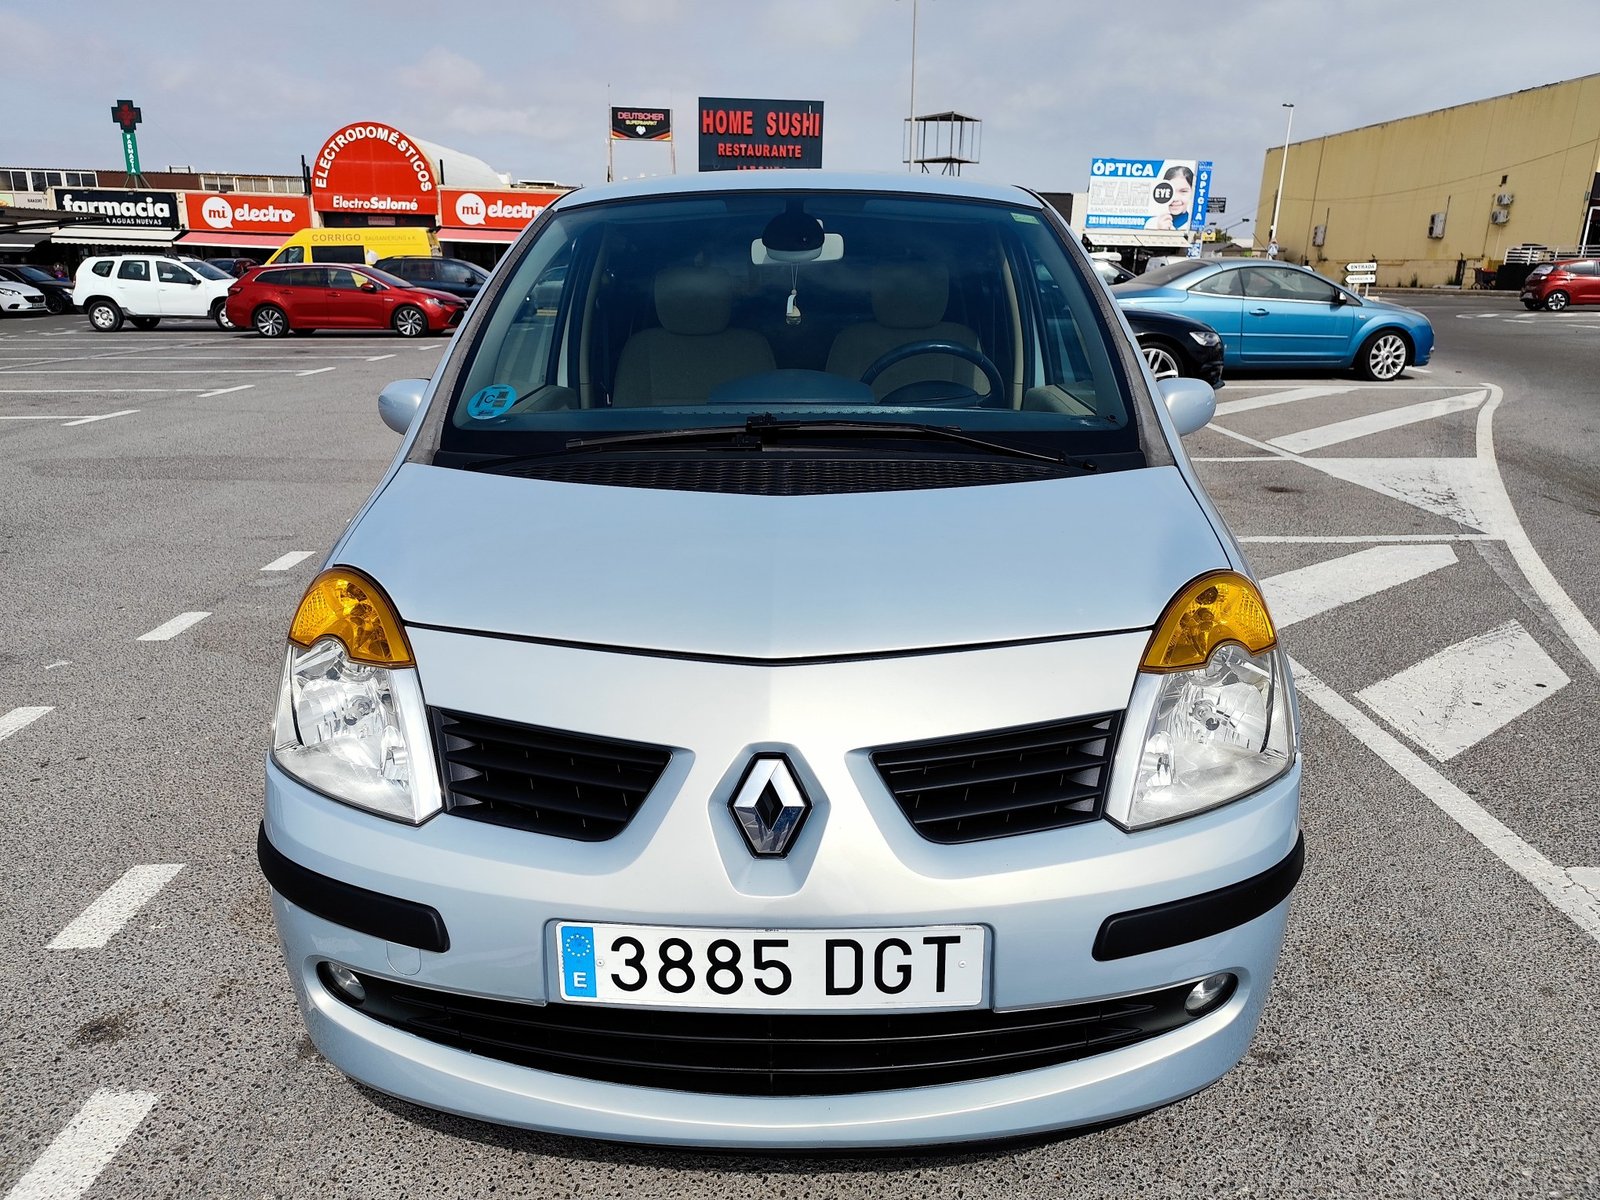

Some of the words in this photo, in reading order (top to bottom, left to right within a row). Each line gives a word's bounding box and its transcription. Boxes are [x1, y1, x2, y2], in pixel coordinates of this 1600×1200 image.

[617, 112, 664, 120] DEUTSCHER
[702, 110, 753, 135] HOME
[766, 112, 820, 137] SUSHI
[126, 134, 136, 173] FARMACIA
[315, 126, 432, 192] ELECTRODOMÉSTICOS
[718, 143, 802, 158] RESTAURANTE
[1092, 159, 1154, 177] ÓPTICA
[1154, 188, 1171, 198] EYE
[62, 194, 170, 217] farmacia
[333, 195, 418, 210] ElectroSalomé
[462, 203, 480, 215] mi
[208, 206, 228, 219] mi
[234, 203, 295, 223] electro
[312, 234, 361, 242] CORRIGO
[573, 971, 588, 988] E
[611, 936, 792, 995] 3885
[825, 935, 961, 996] DGT
